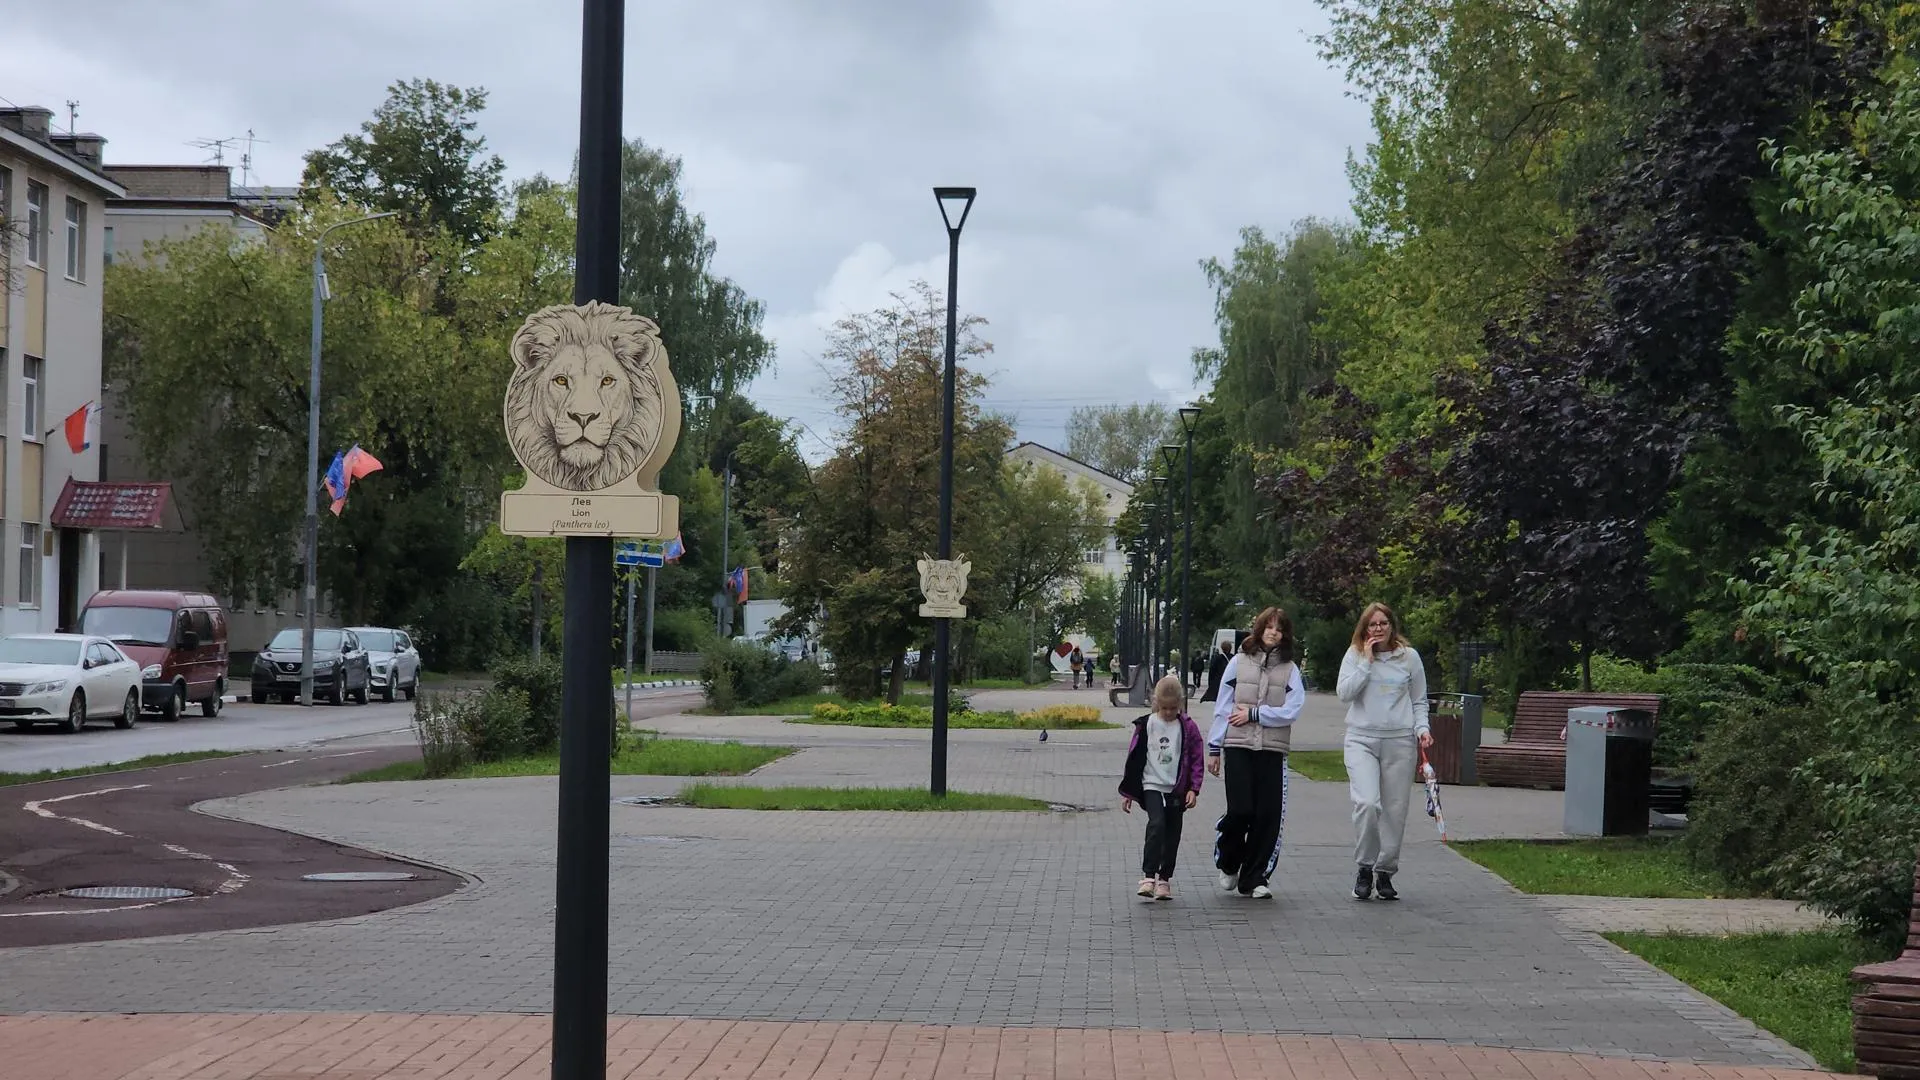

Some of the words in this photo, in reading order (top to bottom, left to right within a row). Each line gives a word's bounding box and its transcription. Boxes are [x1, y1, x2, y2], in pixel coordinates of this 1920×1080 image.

[571, 497, 591, 506] Лев
[571, 509, 591, 517] Lion
[552, 520, 592, 529] (Panthera
[594, 520, 610, 529] leo)
